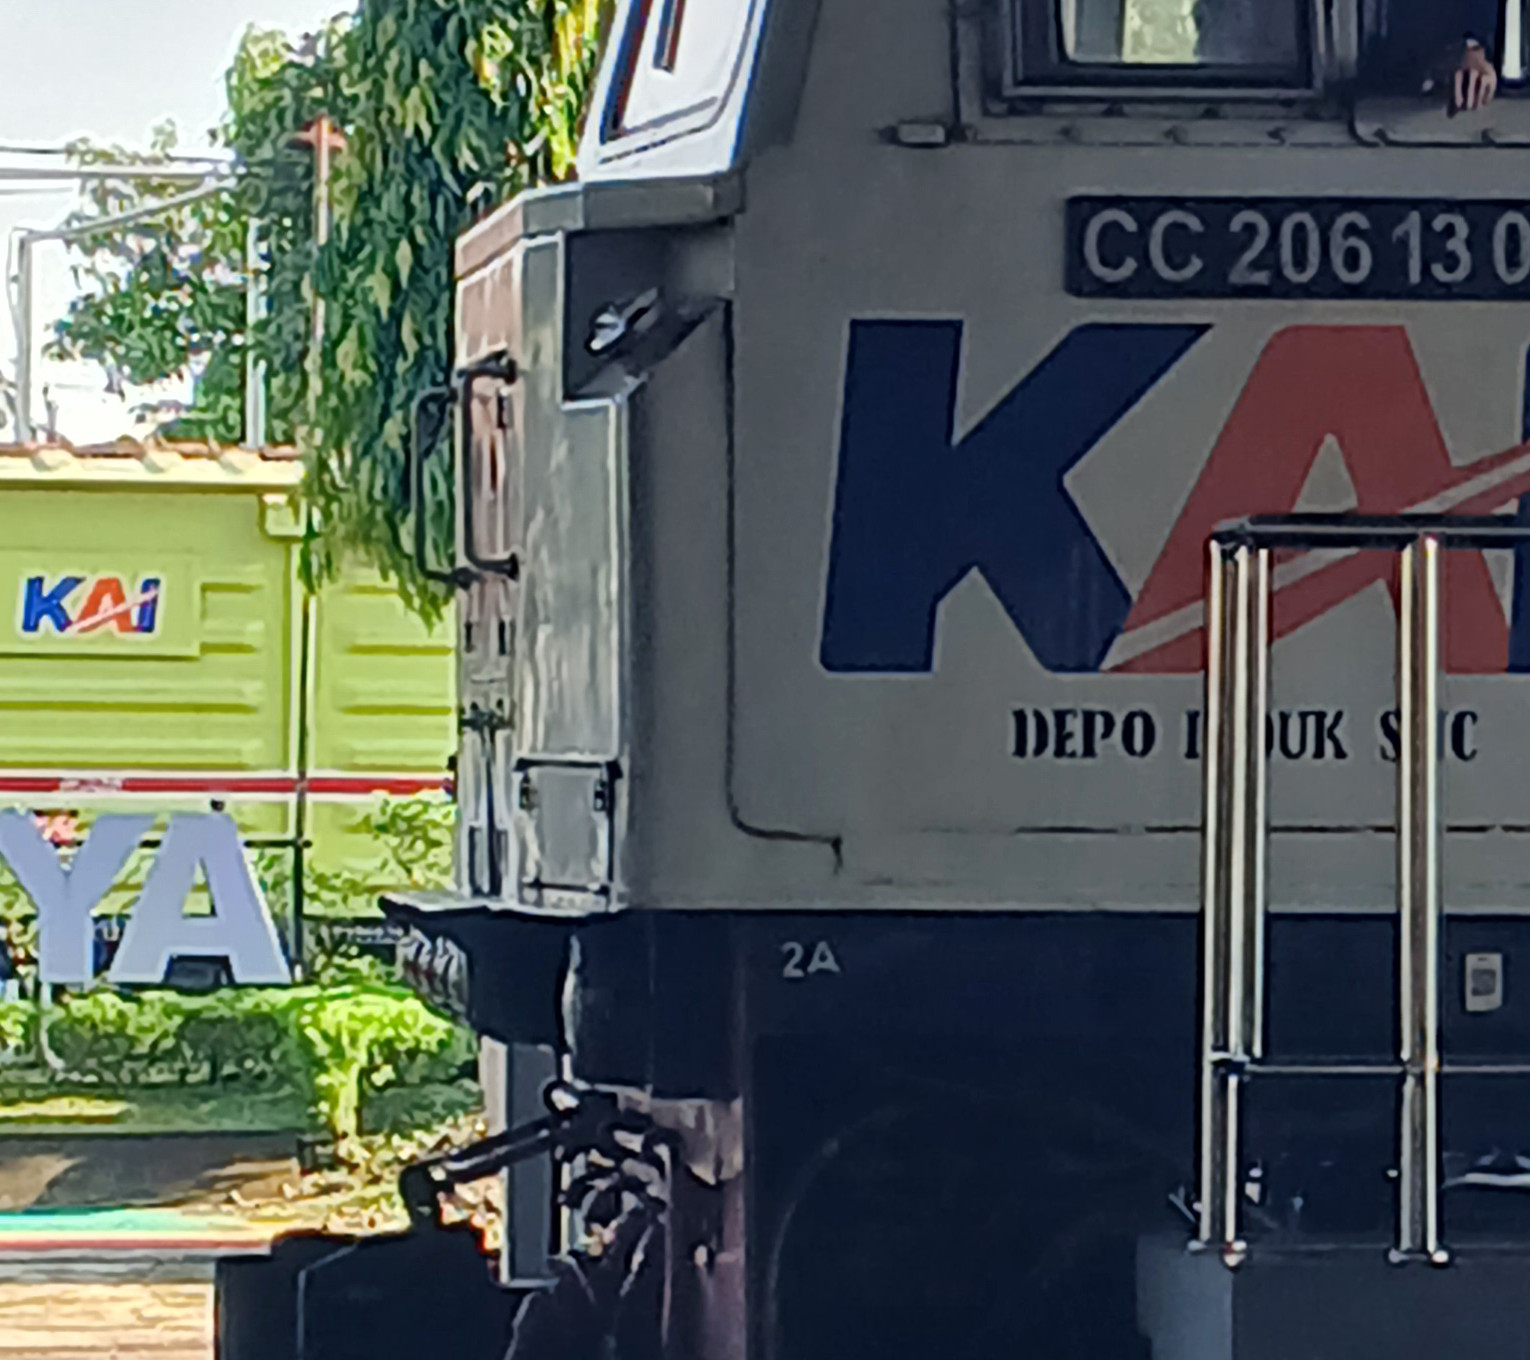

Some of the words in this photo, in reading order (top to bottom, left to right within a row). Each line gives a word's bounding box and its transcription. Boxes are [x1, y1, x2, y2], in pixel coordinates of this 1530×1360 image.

[1083, 208, 1205, 283] CC
[1227, 209, 1373, 285] 206
[1392, 210, 1473, 285] 13
[22, 576, 161, 634] KAI
[1011, 709, 1157, 760] DEPO
[780, 940, 841, 978] 2A
